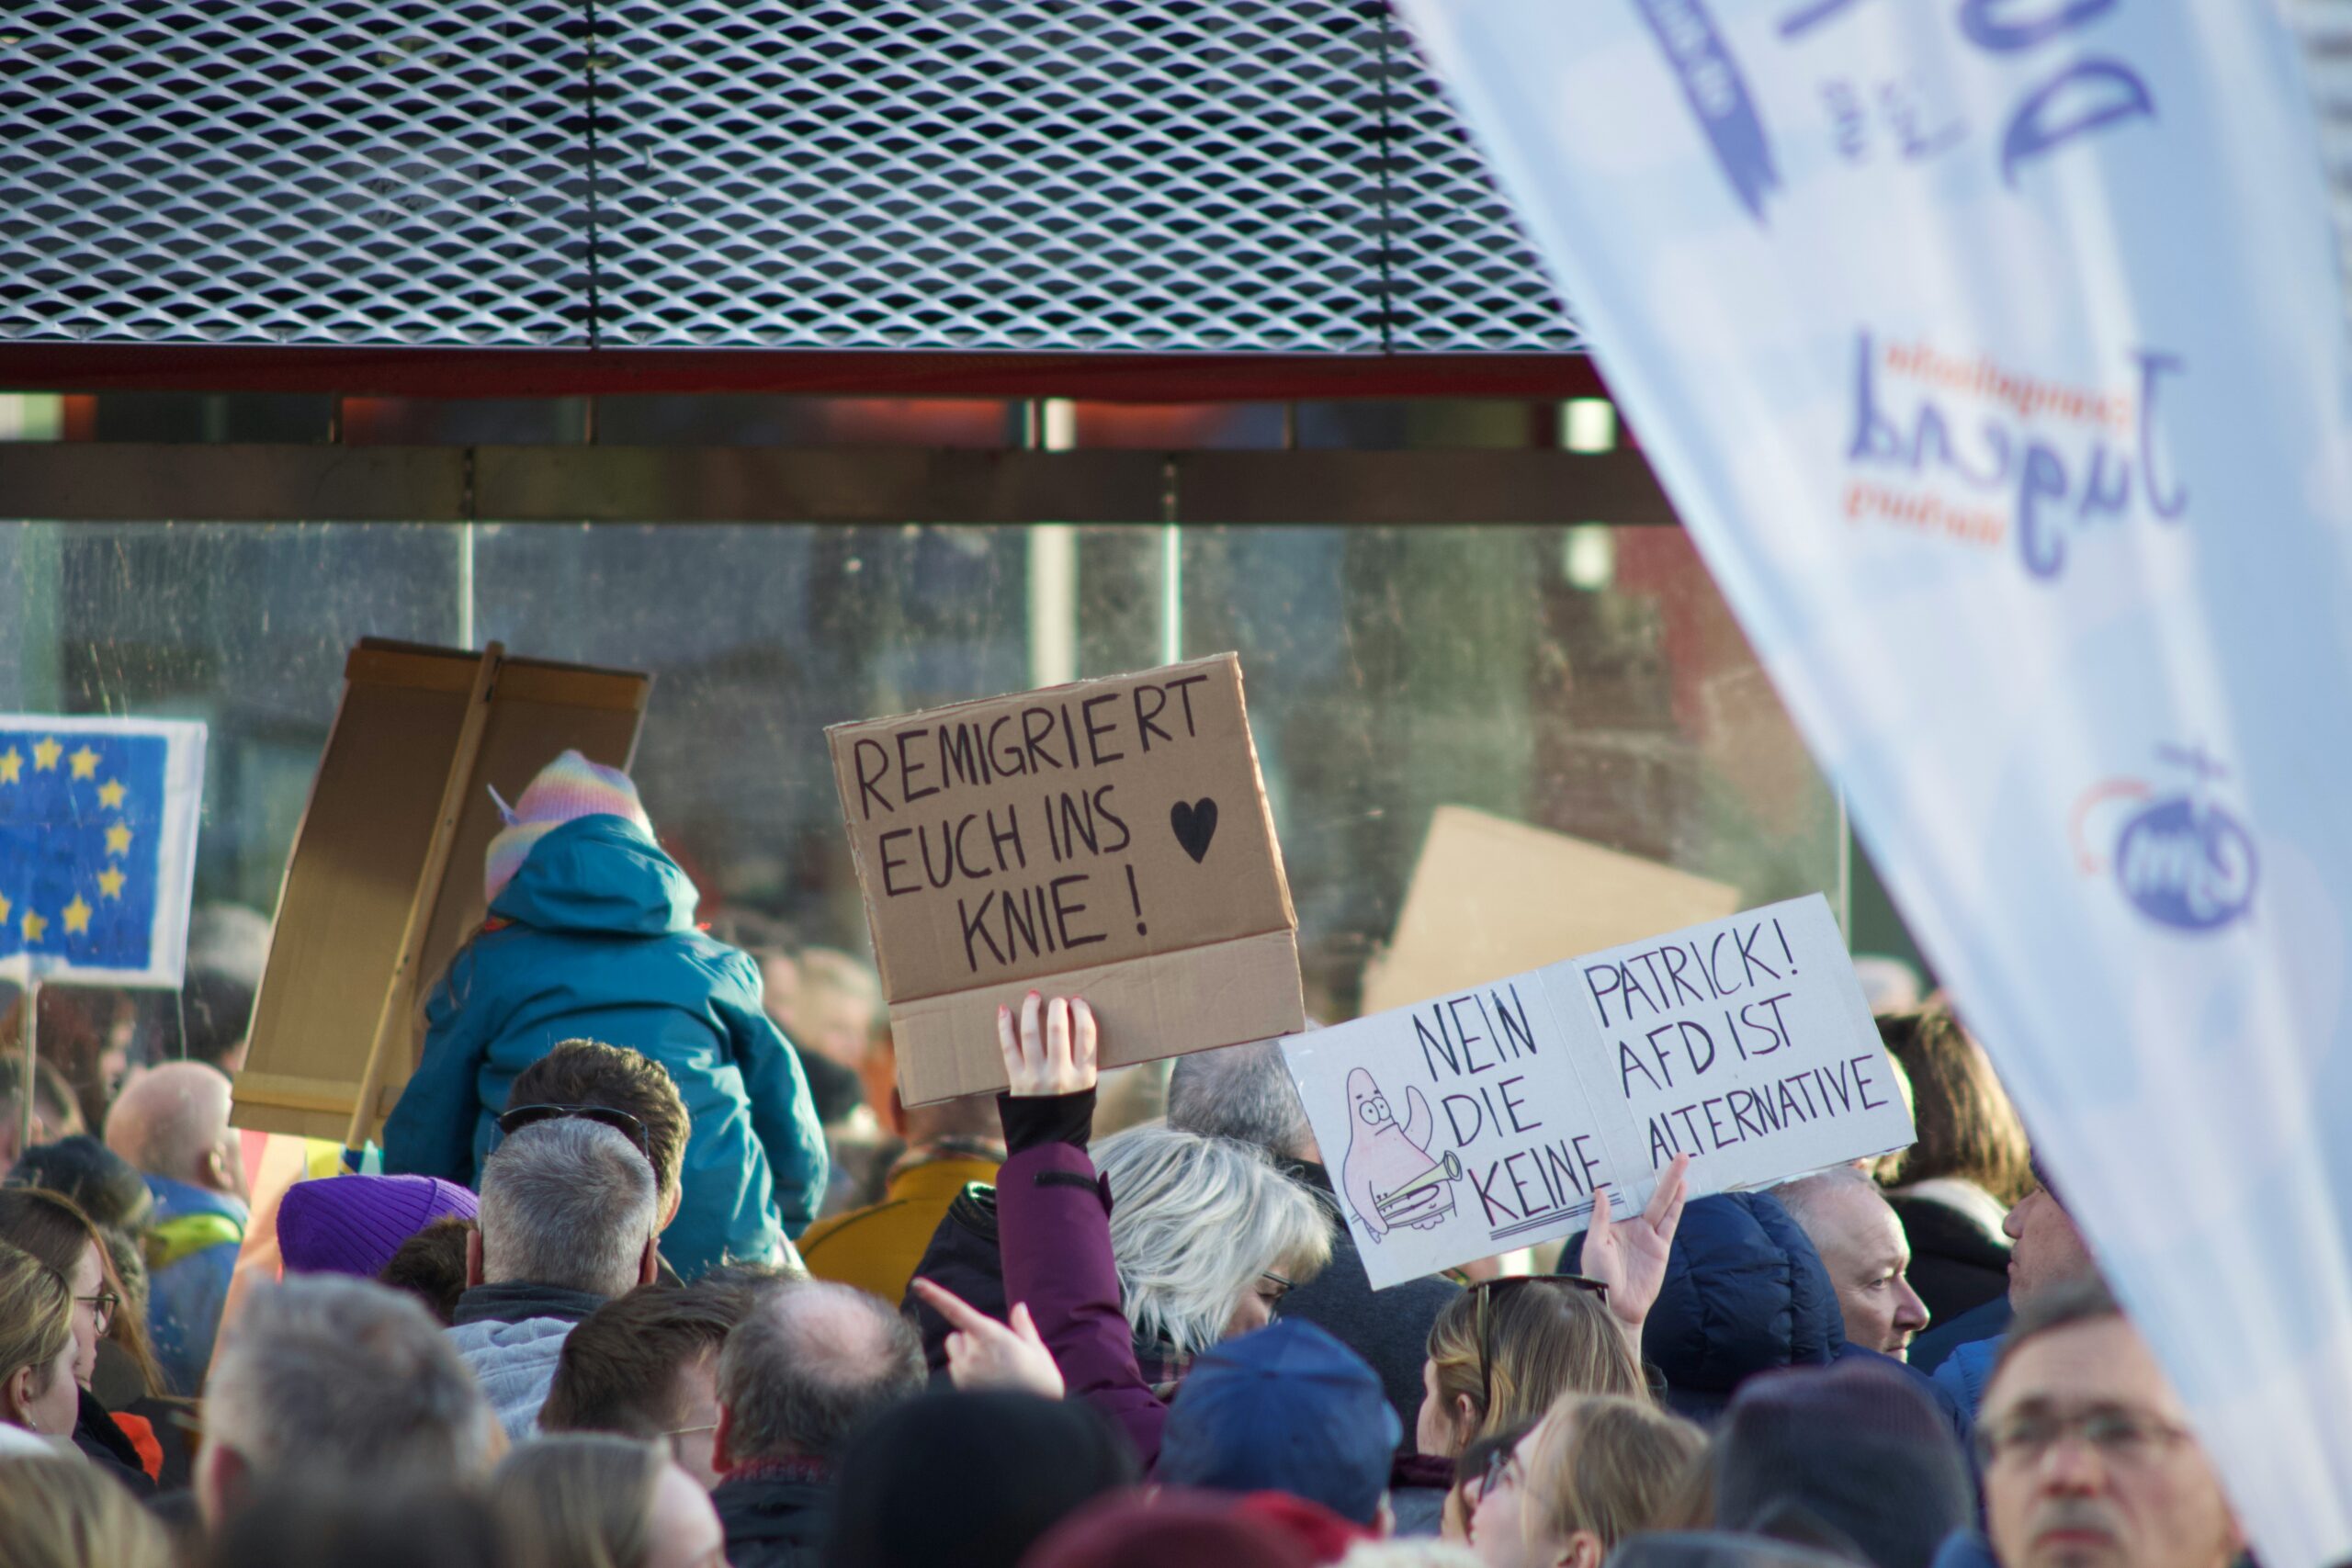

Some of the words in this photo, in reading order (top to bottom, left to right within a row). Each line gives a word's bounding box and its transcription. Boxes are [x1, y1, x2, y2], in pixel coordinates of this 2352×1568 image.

[854, 674, 1208, 820] REMIGRIERT
[879, 805, 1026, 897] EUCH
[1045, 784, 1131, 862] INS
[1411, 983, 1537, 1082] NEIN
[1584, 918, 1799, 1028] PATRICK!
[1441, 1076, 1542, 1148] DIE
[1619, 1020, 1715, 1099] AFD
[1725, 993, 1792, 1062] IST
[1467, 1134, 1612, 1226] KEINE
[1648, 1055, 1888, 1169] ALTERNATIVE
